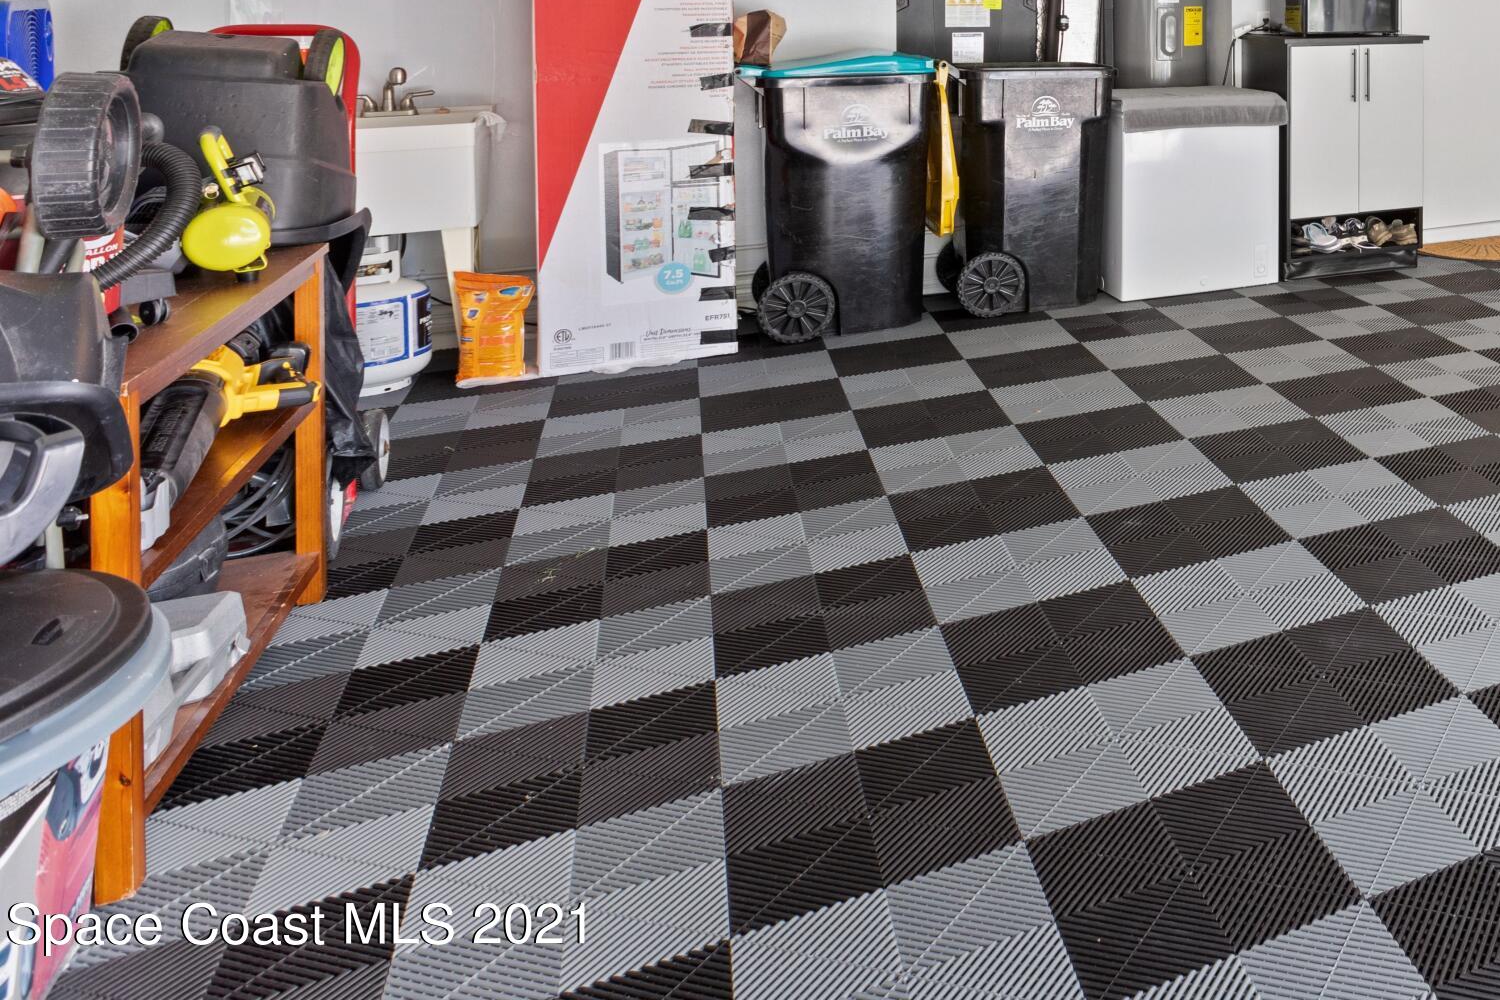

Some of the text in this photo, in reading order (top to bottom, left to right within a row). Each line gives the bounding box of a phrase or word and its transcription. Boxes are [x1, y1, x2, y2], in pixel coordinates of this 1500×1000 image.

[1015, 116, 1075, 129] Palm Bay
[823, 125, 888, 139] Palm Bay
[86, 244, 118, 255] ALLON
[663, 269, 684, 280] 7.5
